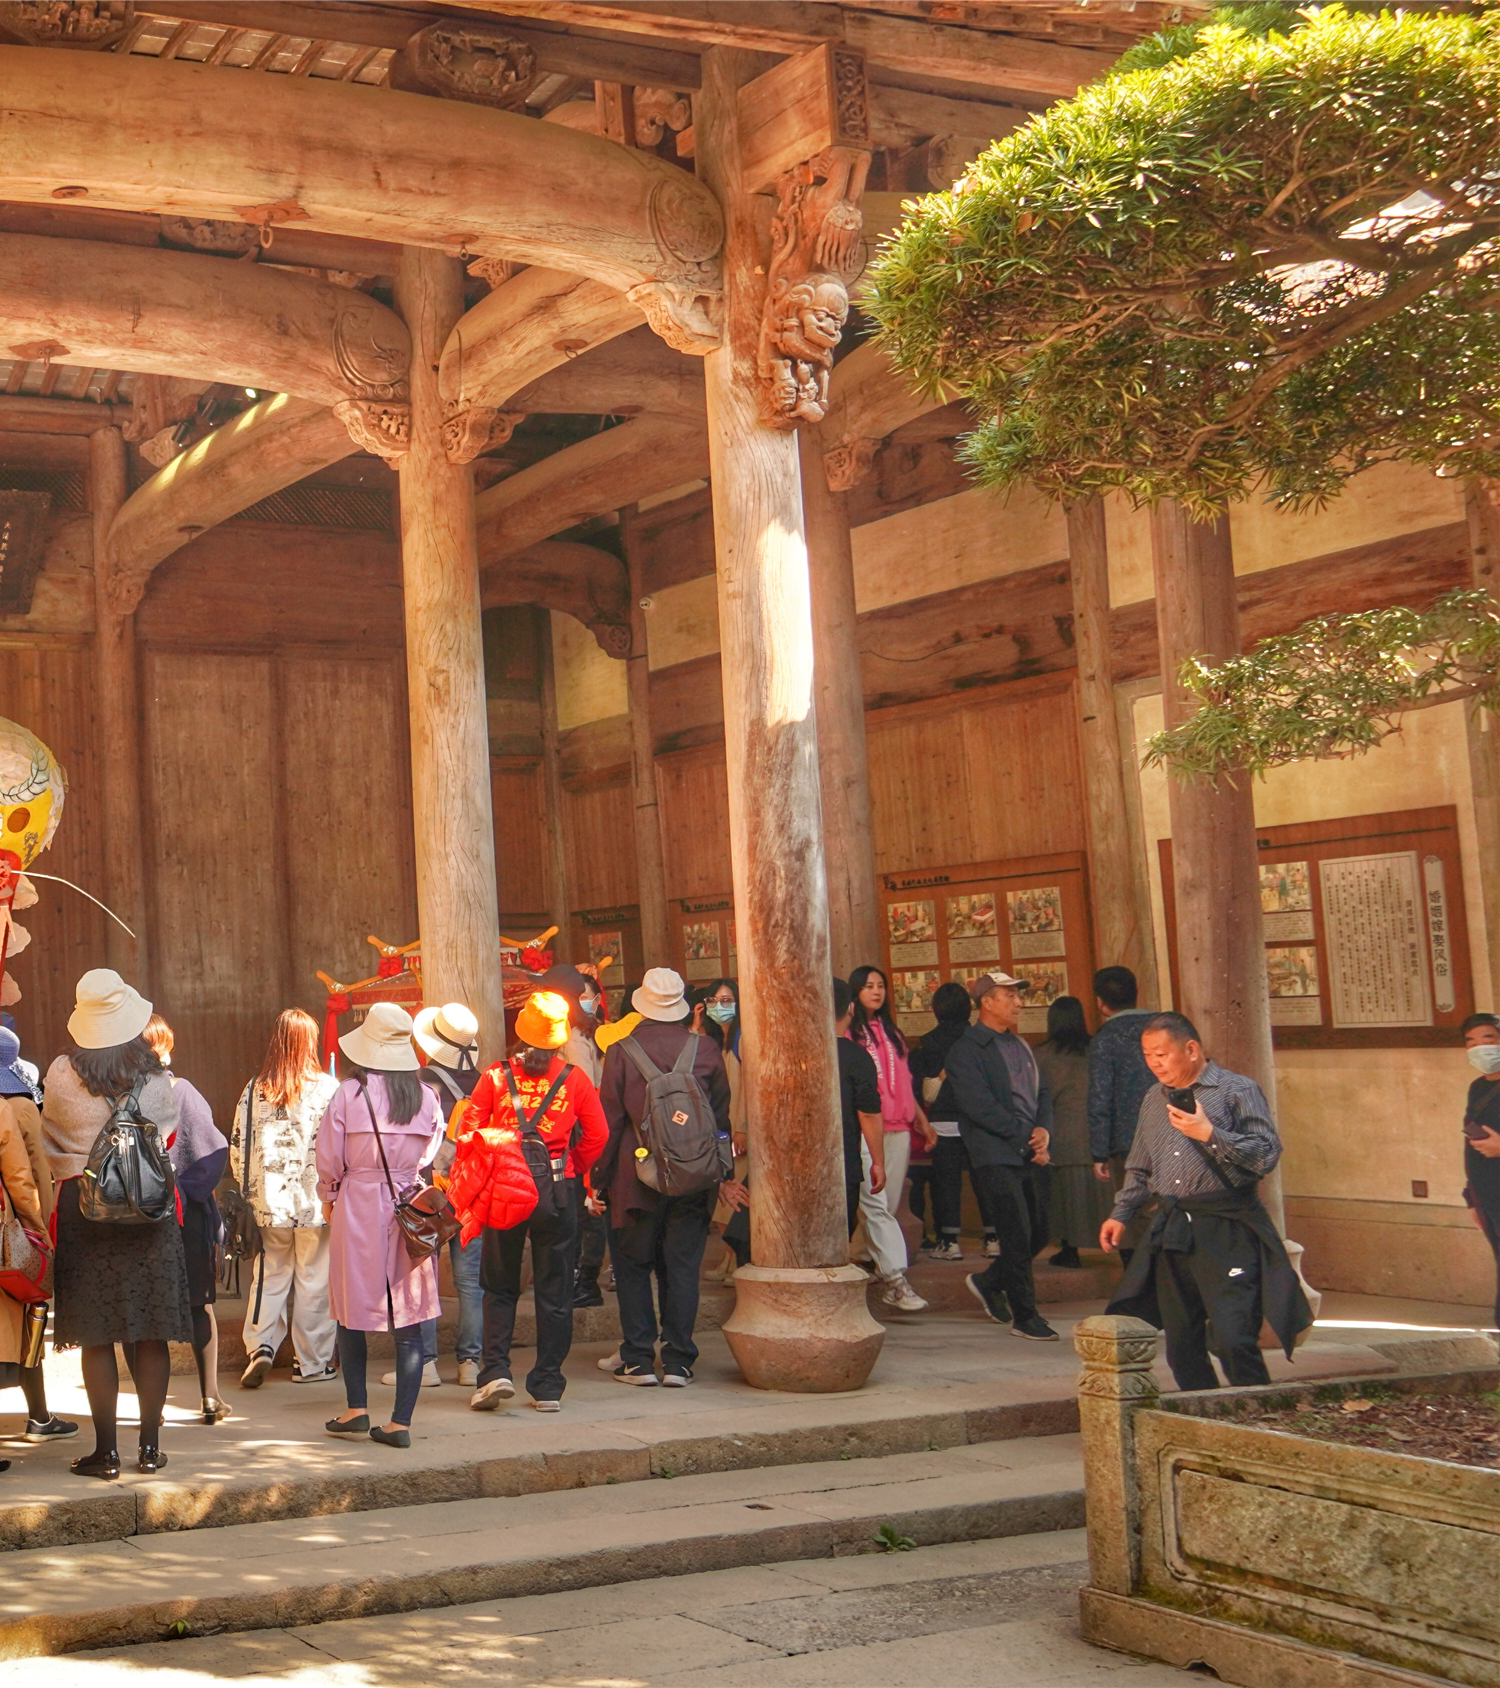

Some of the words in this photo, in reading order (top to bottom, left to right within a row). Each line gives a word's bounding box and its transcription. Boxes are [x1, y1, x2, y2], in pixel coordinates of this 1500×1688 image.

[1428, 890, 1448, 977] 婚姻嫁娶风俗
